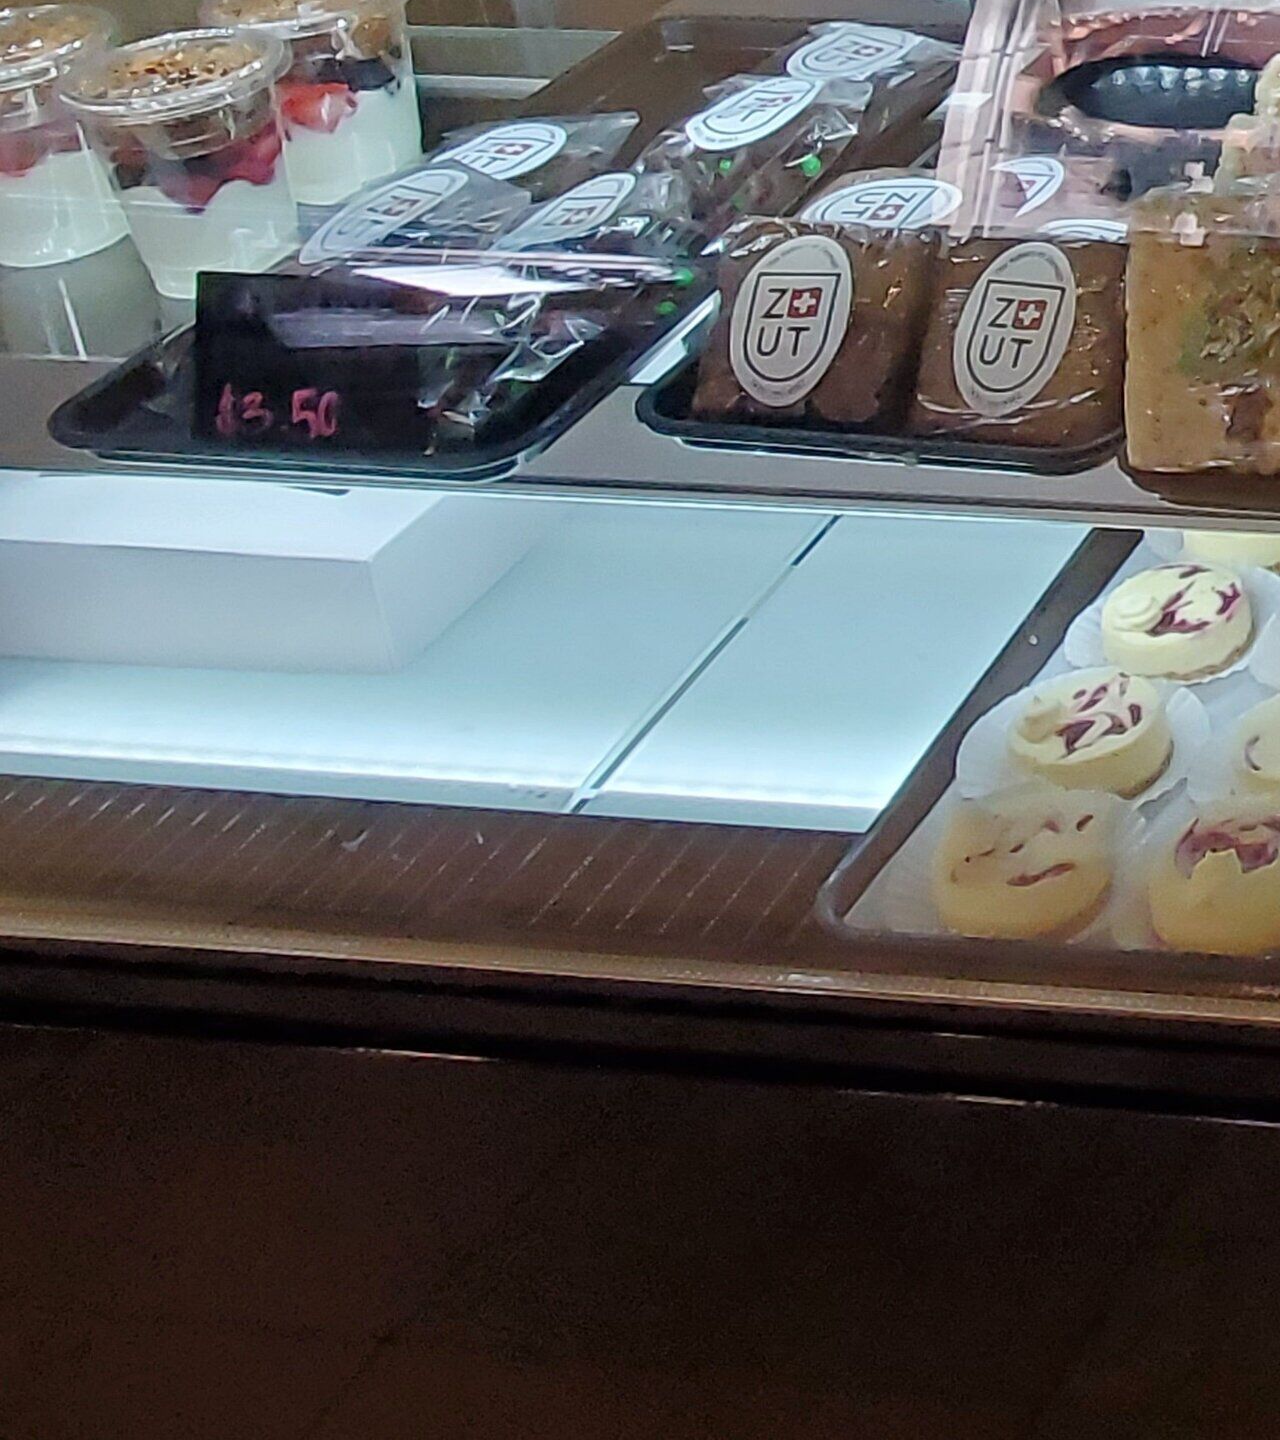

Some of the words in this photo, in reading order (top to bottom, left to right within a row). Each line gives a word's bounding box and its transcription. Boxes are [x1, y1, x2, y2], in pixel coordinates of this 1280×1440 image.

[756, 325, 811, 358] UT
[978, 333, 1034, 370] UT
[214, 383, 344, 439] $3.50
